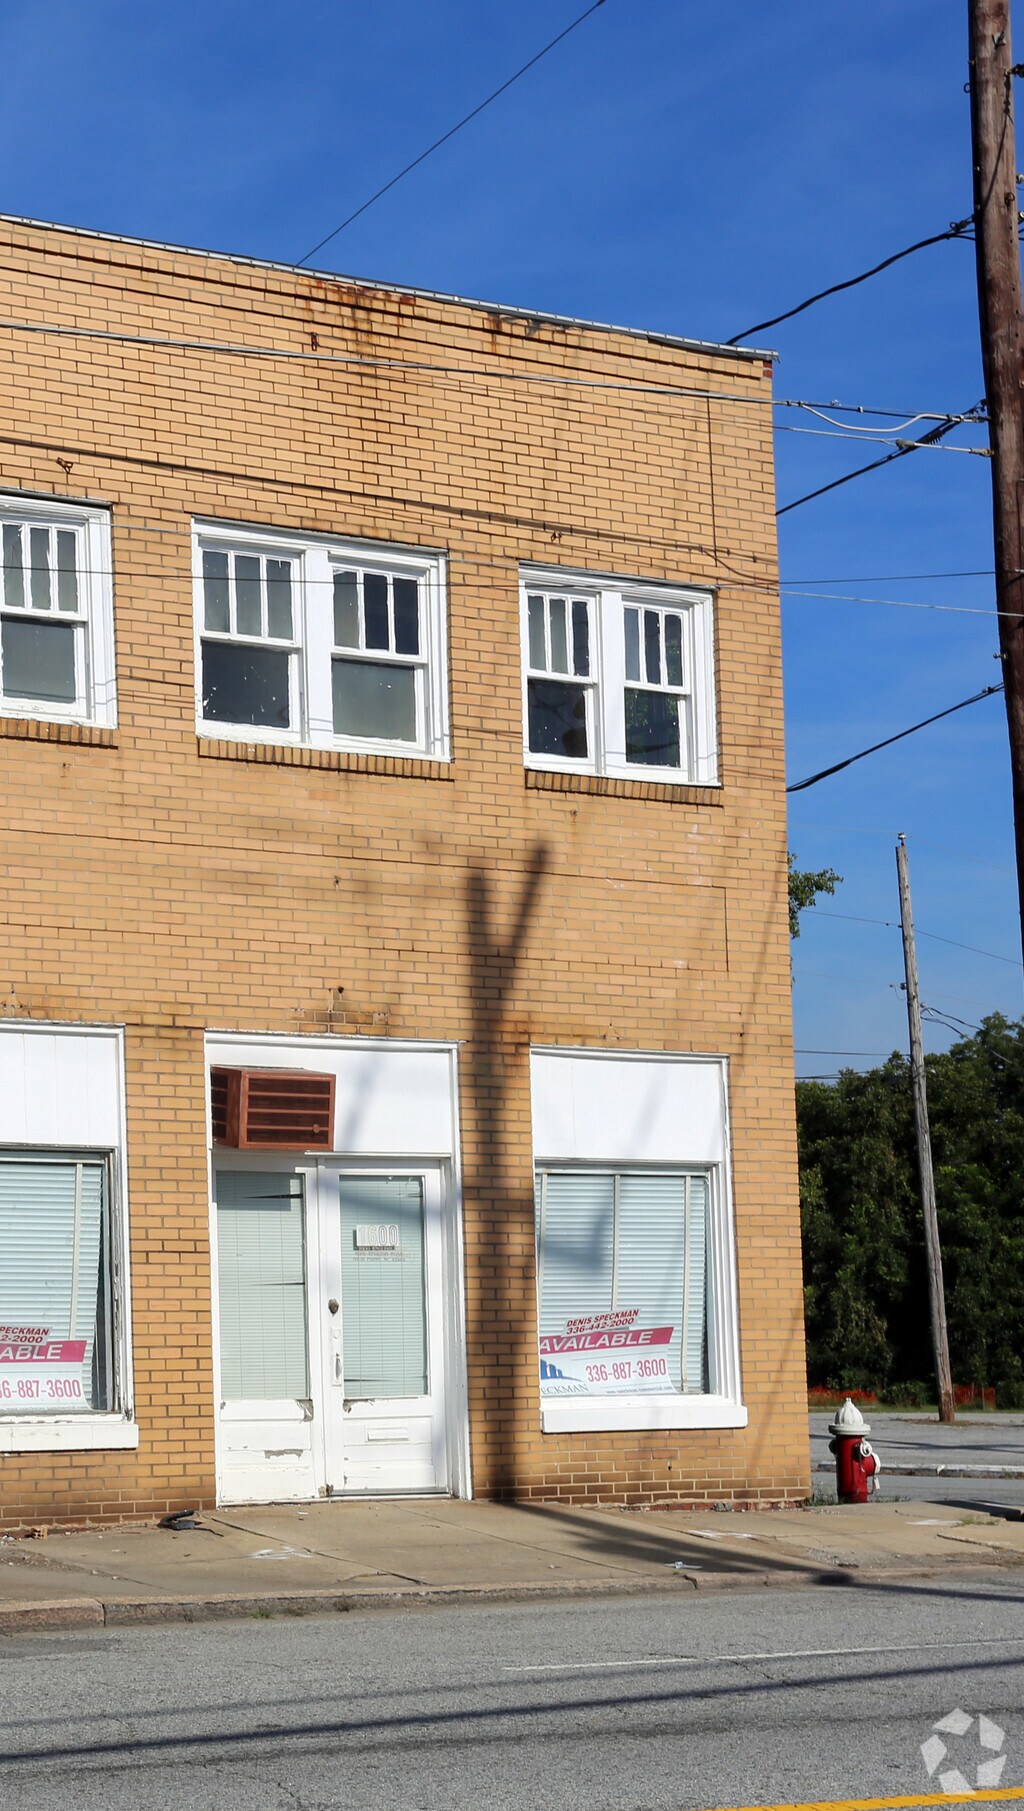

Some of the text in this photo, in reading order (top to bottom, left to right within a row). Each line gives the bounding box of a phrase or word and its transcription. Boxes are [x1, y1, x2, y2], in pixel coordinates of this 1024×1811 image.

[566, 1309, 640, 1327] DENIS SPECKMAN
[566, 1318, 635, 1335] 336-442-2000
[540, 1331, 654, 1352] AVAILABLE
[585, 1358, 667, 1383] 336-887-3600
[540, 1383, 589, 1395] ECKMAN
